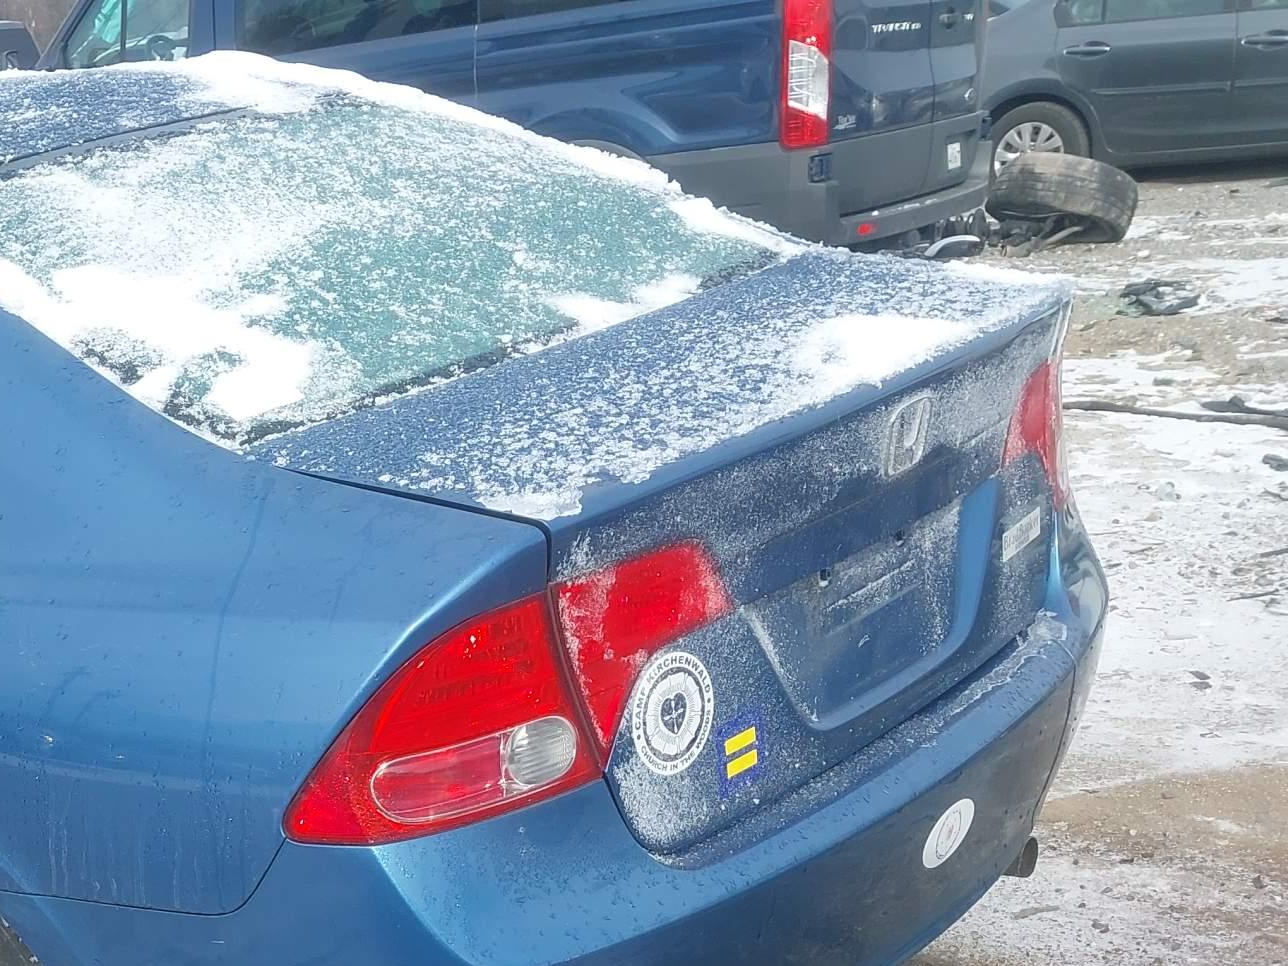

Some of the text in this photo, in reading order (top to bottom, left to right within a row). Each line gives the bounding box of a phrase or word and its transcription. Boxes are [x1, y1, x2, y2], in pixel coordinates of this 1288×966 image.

[647, 655, 711, 693] KIRCHENWALD
[641, 709, 711, 771] CHURCH IN THE WOODS
